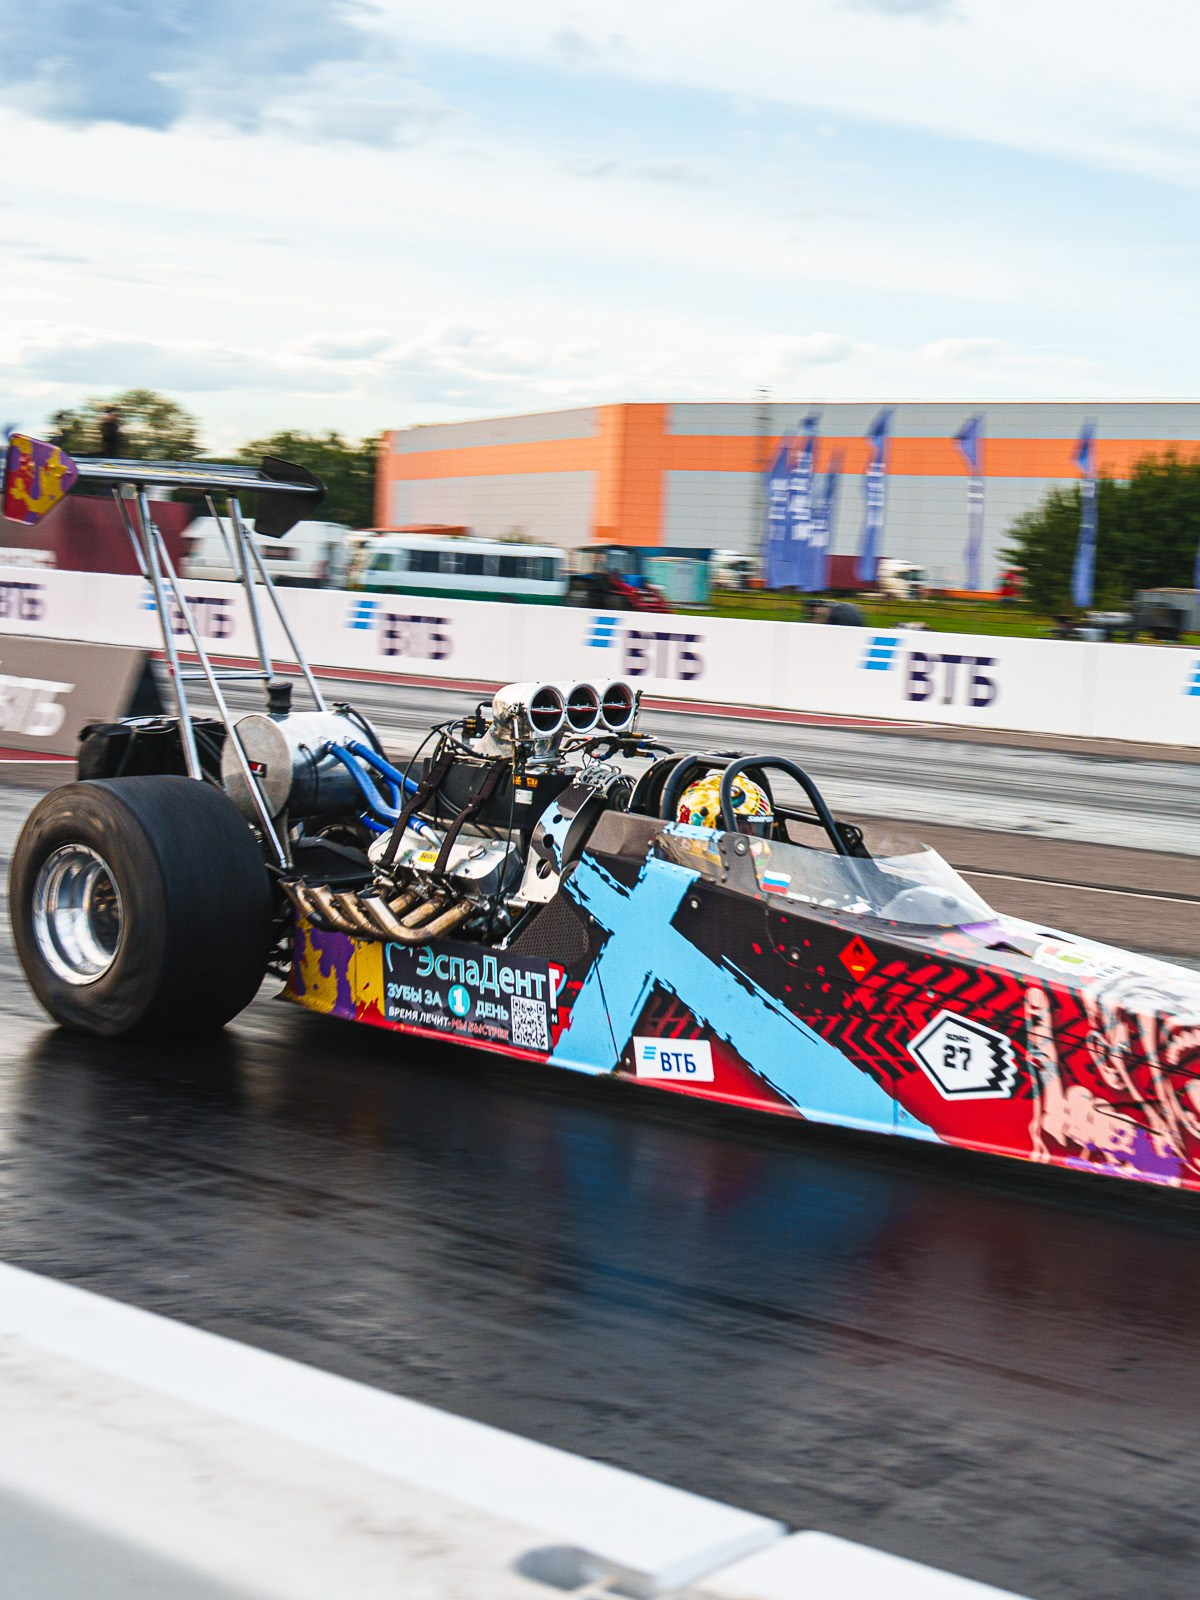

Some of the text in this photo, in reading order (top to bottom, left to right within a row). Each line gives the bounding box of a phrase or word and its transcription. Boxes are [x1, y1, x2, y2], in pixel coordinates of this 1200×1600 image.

[379, 612, 453, 660] ВТБ
[622, 629, 706, 681] ВТБ
[903, 651, 999, 708] ВТБ
[416, 944, 547, 999] ЭспаДент
[387, 982, 509, 1021] ЗУБЫ ЗА 1 ДЕНЬ
[388, 1006, 418, 1020] ВРЕМЯ
[660, 1051, 697, 1073] ВТБ
[943, 1044, 972, 1071] 27
